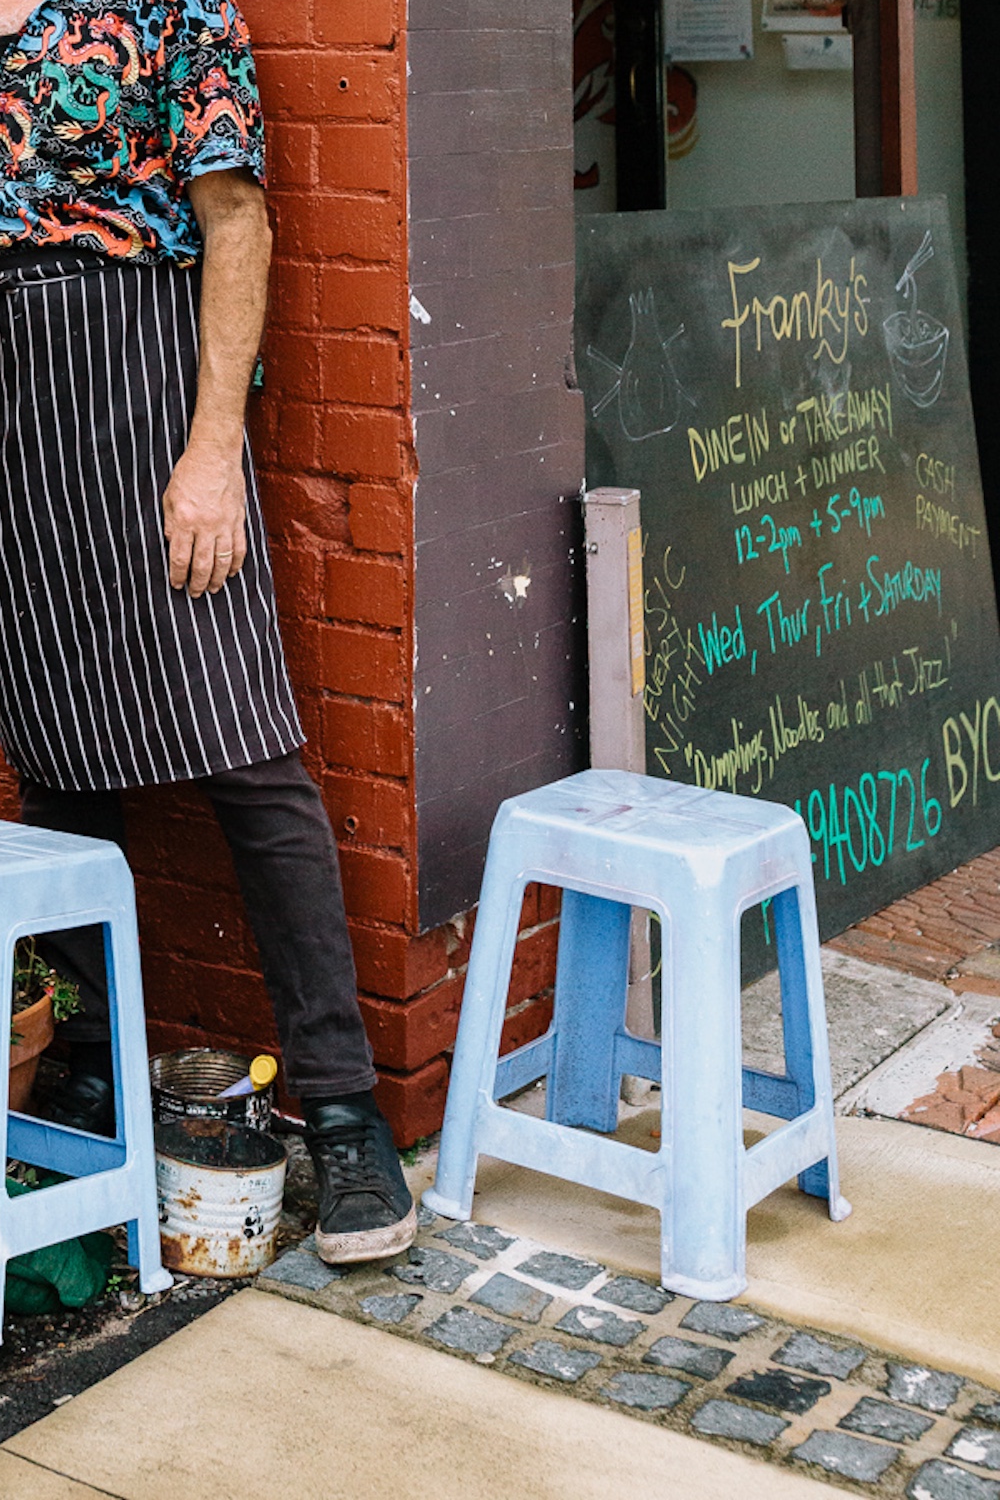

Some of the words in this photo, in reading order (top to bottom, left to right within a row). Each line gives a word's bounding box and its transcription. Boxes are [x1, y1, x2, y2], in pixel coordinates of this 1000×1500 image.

[721, 257, 869, 388] Franky's
[796, 382, 893, 446] TAKEAWAY
[731, 470, 789, 515] LUNCH
[812, 435, 886, 490] DINNER
[916, 452, 955, 502] CASH
[735, 514, 803, 575] 12-2pm
[826, 487, 886, 538] 5-9pm
[916, 493, 981, 559] PAYMENT
